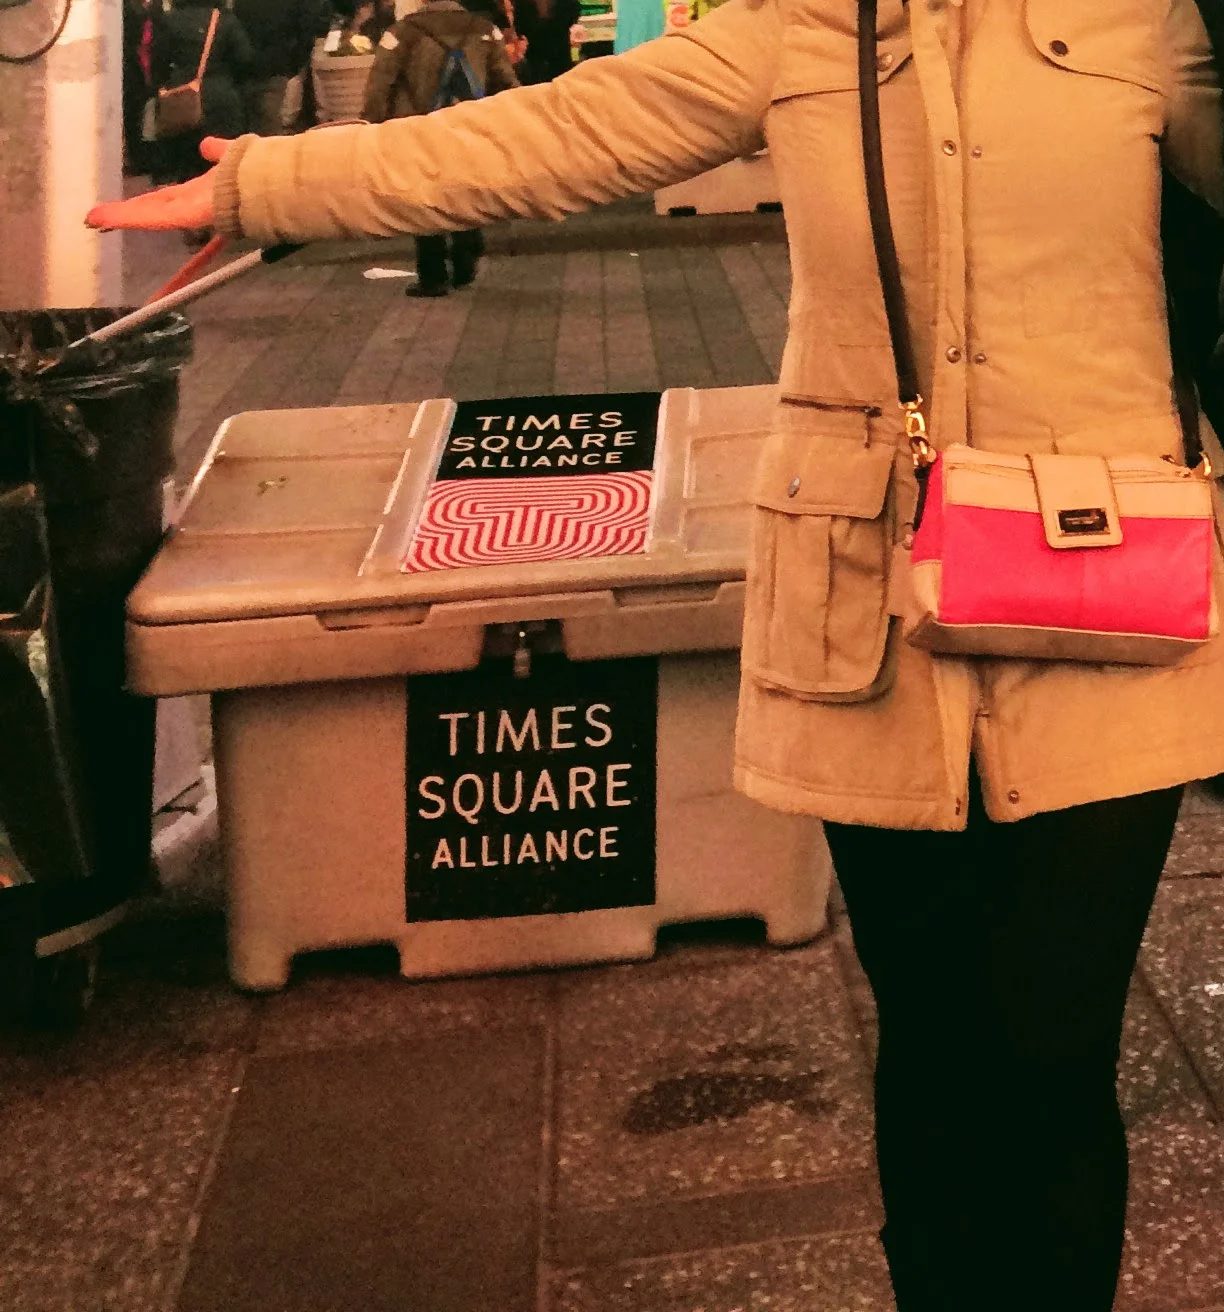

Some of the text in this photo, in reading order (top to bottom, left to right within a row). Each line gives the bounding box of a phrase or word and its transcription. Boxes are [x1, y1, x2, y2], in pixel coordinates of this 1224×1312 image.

[476, 411, 624, 432] TIMES
[450, 431, 638, 454] SQUARE
[456, 451, 624, 469] ALLIANCE
[438, 703, 613, 756] TIMES
[418, 763, 633, 825] SQUARE
[431, 826, 620, 869] ALLIANCE
